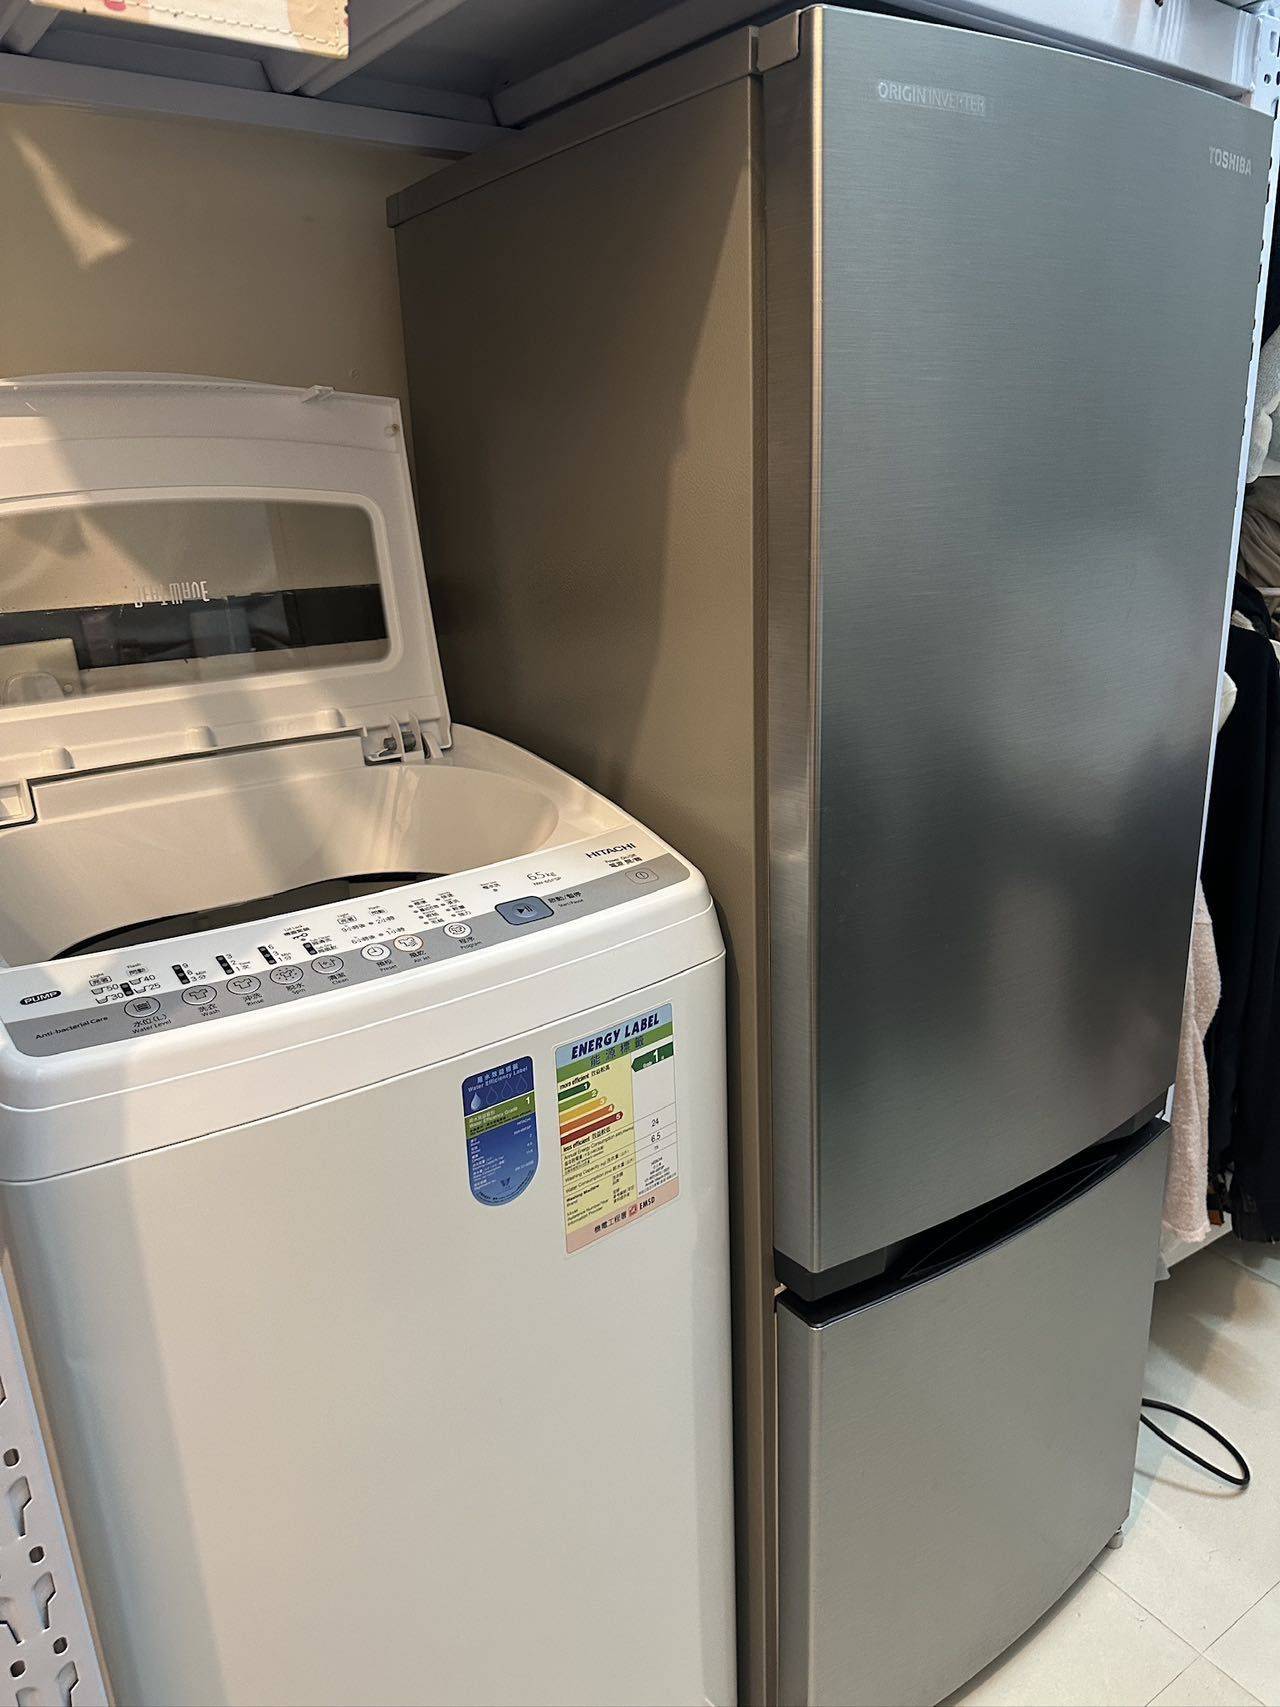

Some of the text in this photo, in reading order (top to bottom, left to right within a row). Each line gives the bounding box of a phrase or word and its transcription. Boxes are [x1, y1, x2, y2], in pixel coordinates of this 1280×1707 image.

[878, 81, 927, 105] ORIGIN
[1209, 146, 1252, 176] TOSHIBA
[585, 842, 636, 859] HITACHI
[380, 964, 397, 972] Preset
[24, 991, 58, 1005] PUMP
[112, 992, 124, 1000] 30
[202, 1009, 220, 1017] Wash
[35, 1016, 108, 1039] Anti-bacterial Care
[132, 1014, 167, 1028] 水位(L)
[132, 1020, 171, 1034] Water Level
[571, 1013, 660, 1060] ENERGY LABEL
[653, 1049, 659, 1062] 1
[467, 1066, 528, 1093] Water Efficiency Label
[560, 1081, 571, 1090] more
[525, 1096, 530, 1105] 1
[651, 1118, 659, 1127] 24
[639, 1196, 656, 1210] EMSD
